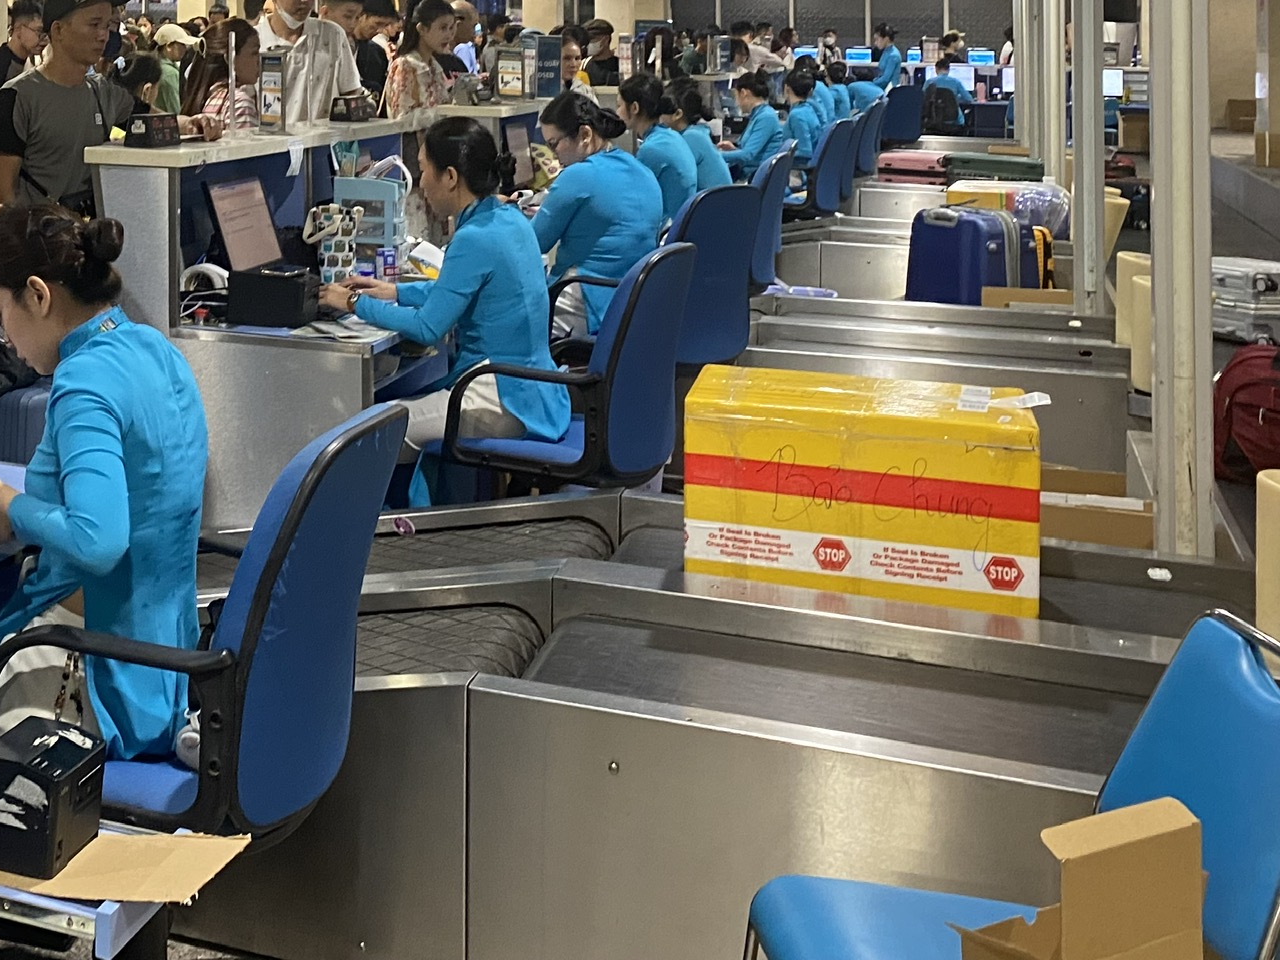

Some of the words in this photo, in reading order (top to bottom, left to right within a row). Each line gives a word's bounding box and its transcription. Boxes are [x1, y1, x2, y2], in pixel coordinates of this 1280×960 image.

[872, 457, 993, 572] Chung
[726, 528, 743, 536] Seal
[753, 531, 781, 540] Broken
[706, 540, 729, 549] Check
[732, 543, 766, 554] Contents
[768, 548, 794, 556] Before
[720, 534, 753, 545] Package
[754, 539, 791, 549] Damaged
[720, 549, 748, 560] Signing
[749, 553, 779, 563] Receipt
[818, 548, 846, 562] STOP
[891, 547, 908, 555] Seal
[920, 551, 949, 559] Broken
[870, 560, 895, 568] Check
[897, 563, 933, 573] Contents
[936, 567, 963, 576] Before
[884, 554, 919, 565] Package
[921, 558, 960, 568] Damaged
[884, 569, 915, 580] Signing
[916, 572, 948, 582] Receipt
[989, 566, 1018, 582] STOP
